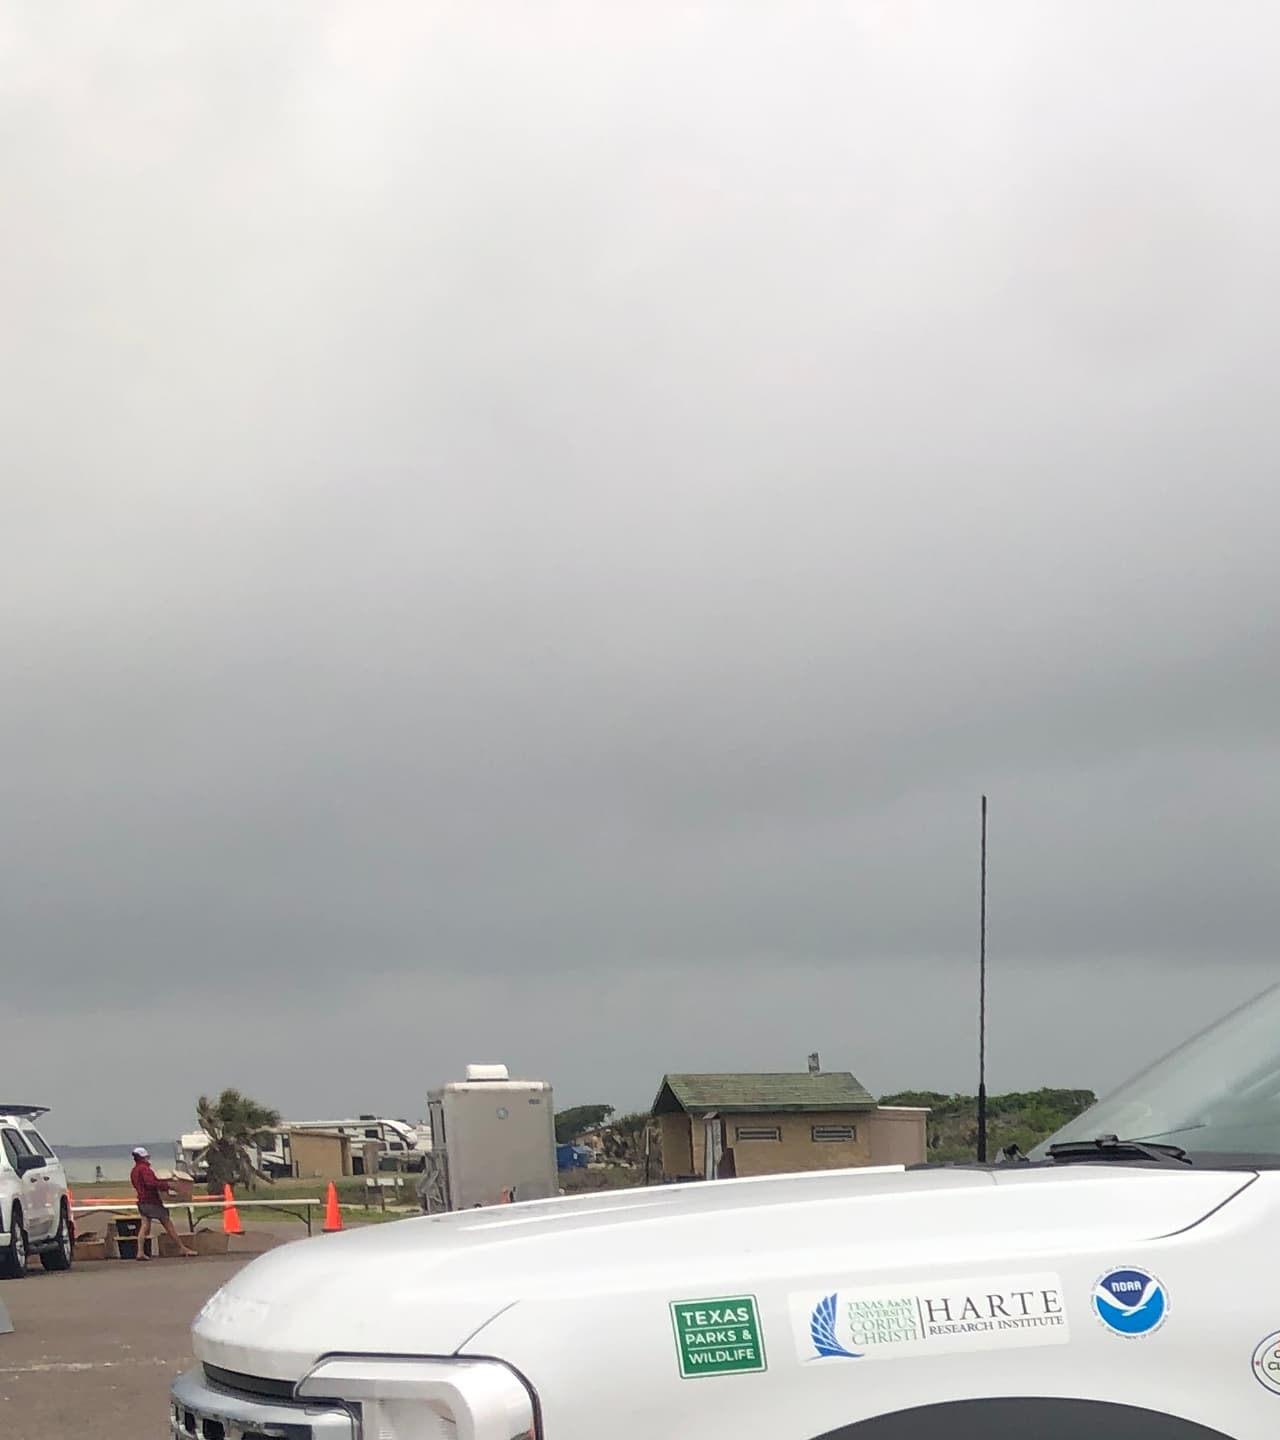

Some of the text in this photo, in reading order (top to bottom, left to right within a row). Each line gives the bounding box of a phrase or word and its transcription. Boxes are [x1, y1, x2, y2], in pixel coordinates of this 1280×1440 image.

[1111, 1280, 1142, 1293] NOAA
[848, 1307, 914, 1320] UNIVERSITY
[924, 1290, 1063, 1323] HARTE
[681, 1307, 750, 1327] TEXAS
[850, 1317, 917, 1333] CORPUS
[929, 1315, 1065, 1335] RESEARCH INSTITUTE
[685, 1329, 753, 1345] PARKS &
[852, 1329, 917, 1345] CHRISTI
[688, 1348, 756, 1365] WILDLIFE
